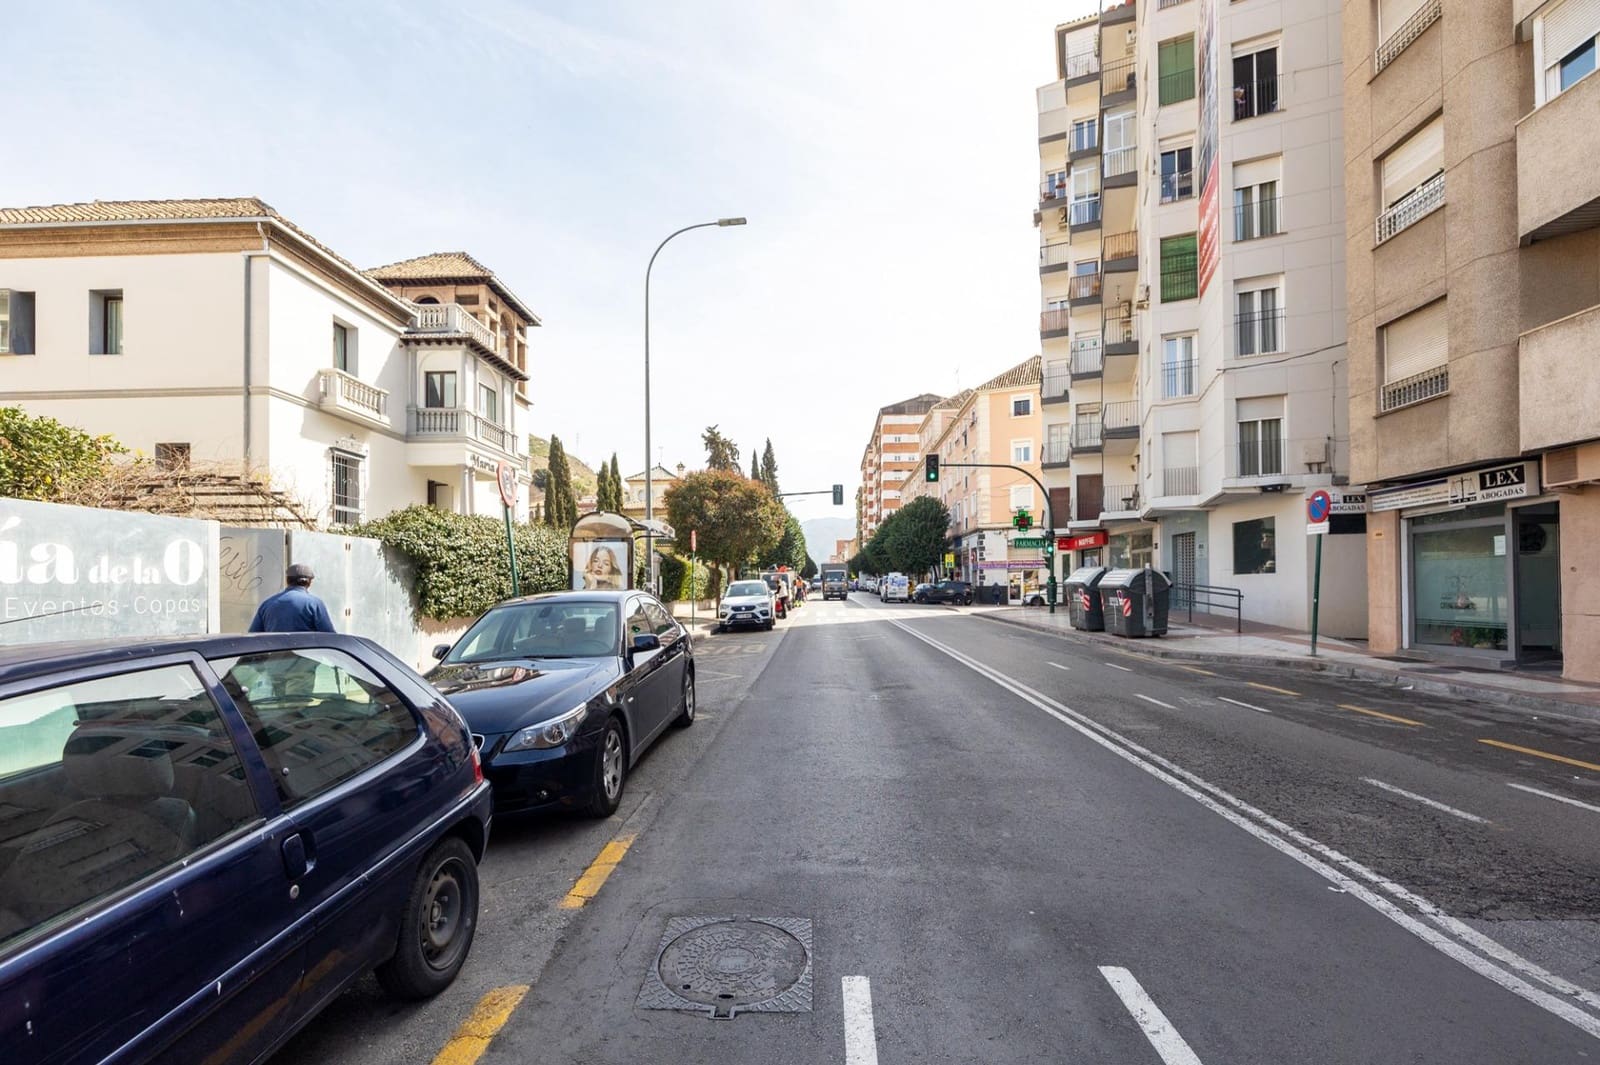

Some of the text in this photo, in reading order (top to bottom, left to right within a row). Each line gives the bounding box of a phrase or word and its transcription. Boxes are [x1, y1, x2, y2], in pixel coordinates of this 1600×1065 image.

[1484, 468, 1520, 488] LEX
[1346, 495, 1363, 503] LEX
[1480, 487, 1525, 500] ABOGADAS
[1015, 538, 1045, 548] FARMACIA
[163, 538, 204, 586] O
